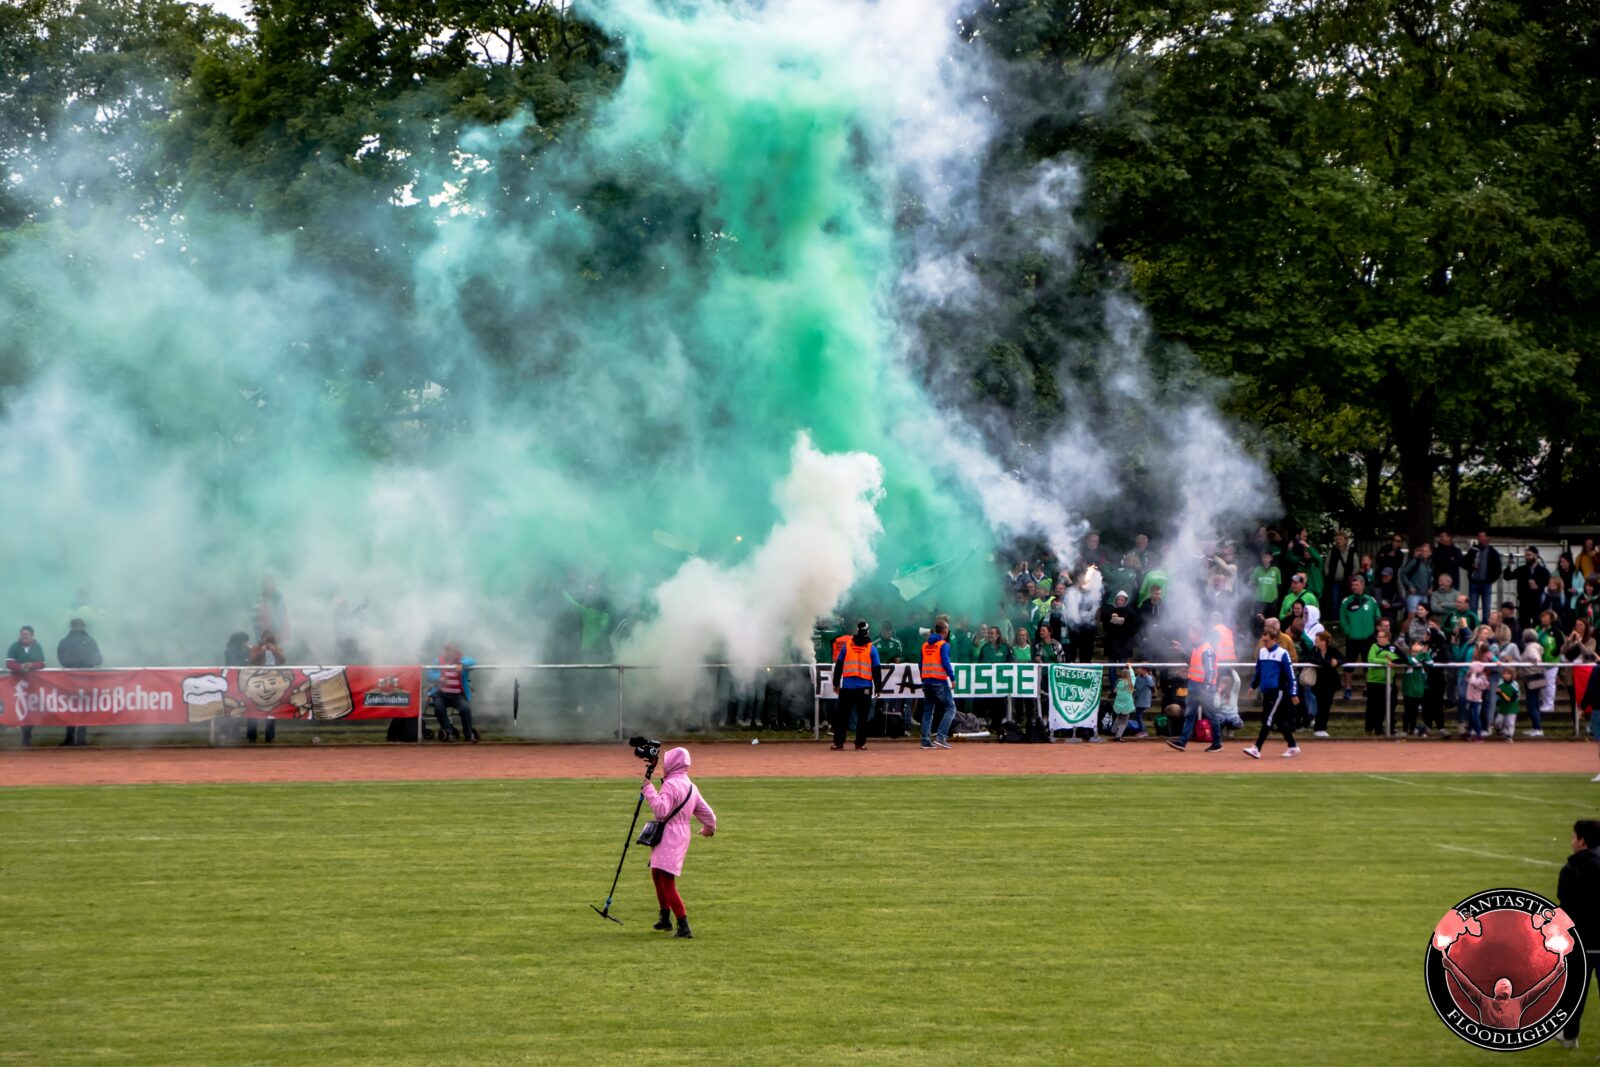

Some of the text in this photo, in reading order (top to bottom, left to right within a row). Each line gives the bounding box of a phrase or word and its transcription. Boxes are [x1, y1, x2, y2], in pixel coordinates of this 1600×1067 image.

[816, 665, 917, 695] FZA
[1055, 669, 1093, 679] DRESDEN
[14, 680, 173, 720] Feldschlößchen
[1057, 683, 1089, 700] TSV
